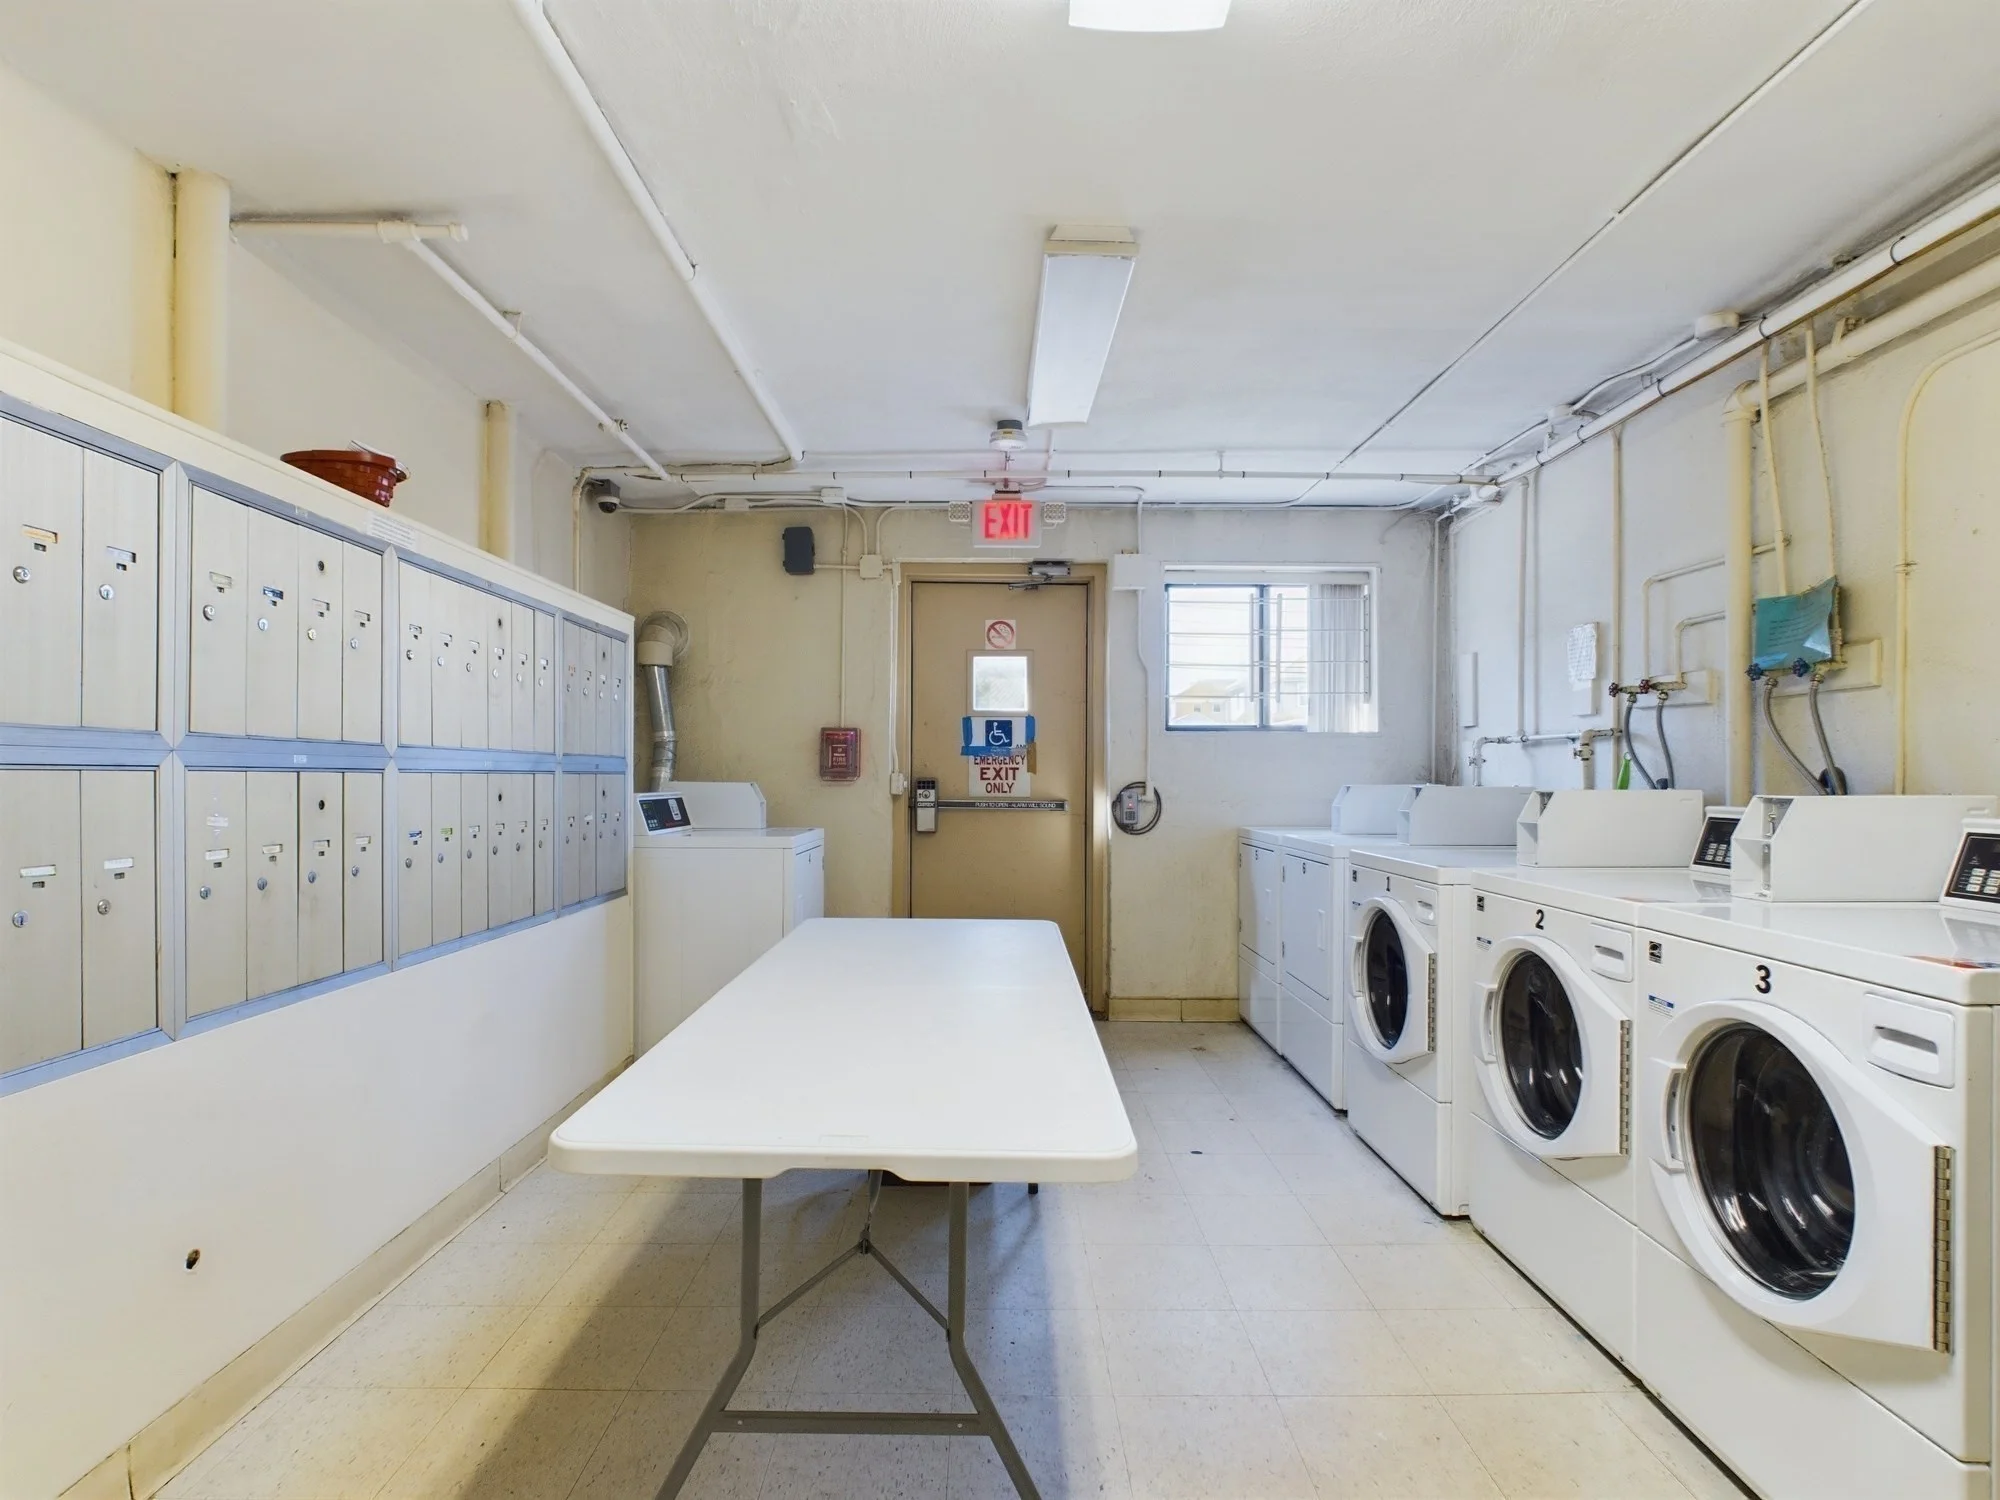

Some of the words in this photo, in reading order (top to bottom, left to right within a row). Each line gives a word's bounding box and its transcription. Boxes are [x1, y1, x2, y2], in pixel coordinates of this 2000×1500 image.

[984, 503, 1032, 538] EXIT
[974, 754, 1026, 766] EMERGENCY
[980, 767, 1019, 781] EXIT
[985, 782, 1014, 794] ONLY
[1386, 876, 1391, 892] 1
[1535, 908, 1545, 930] 2
[1754, 964, 1771, 994] 3
